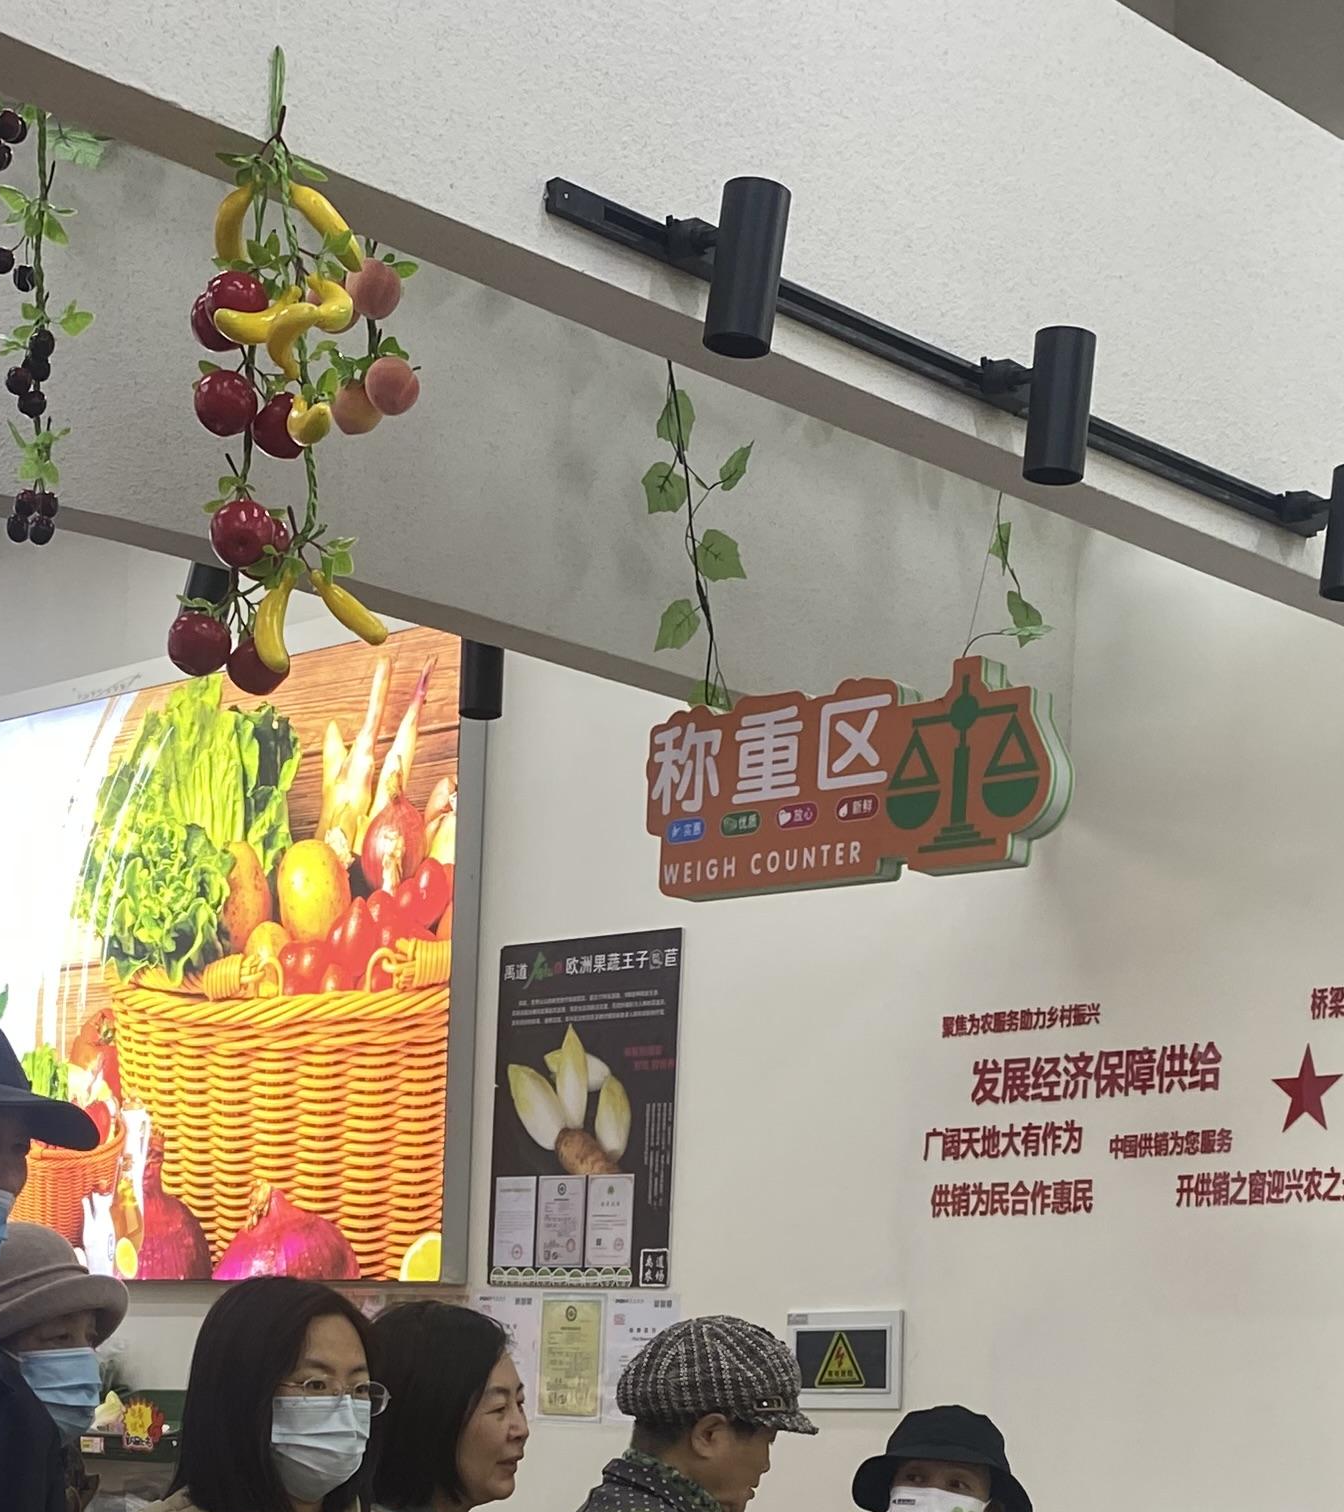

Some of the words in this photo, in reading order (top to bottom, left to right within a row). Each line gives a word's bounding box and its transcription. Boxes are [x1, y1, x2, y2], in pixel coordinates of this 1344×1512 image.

[652, 694, 892, 815] 称重区
[663, 856, 736, 885] WEIGH
[751, 841, 862, 875] COUNTER
[942, 1003, 1101, 1038] 聚焦为农服务助力乡村振兴
[971, 1041, 1222, 1105] 发展经济保障供给
[923, 1120, 1082, 1161] 广阔天地大有作为
[1109, 1128, 1233, 1160] 中国供销为您服务
[931, 1179, 1093, 1218] 供销为民合作惠民
